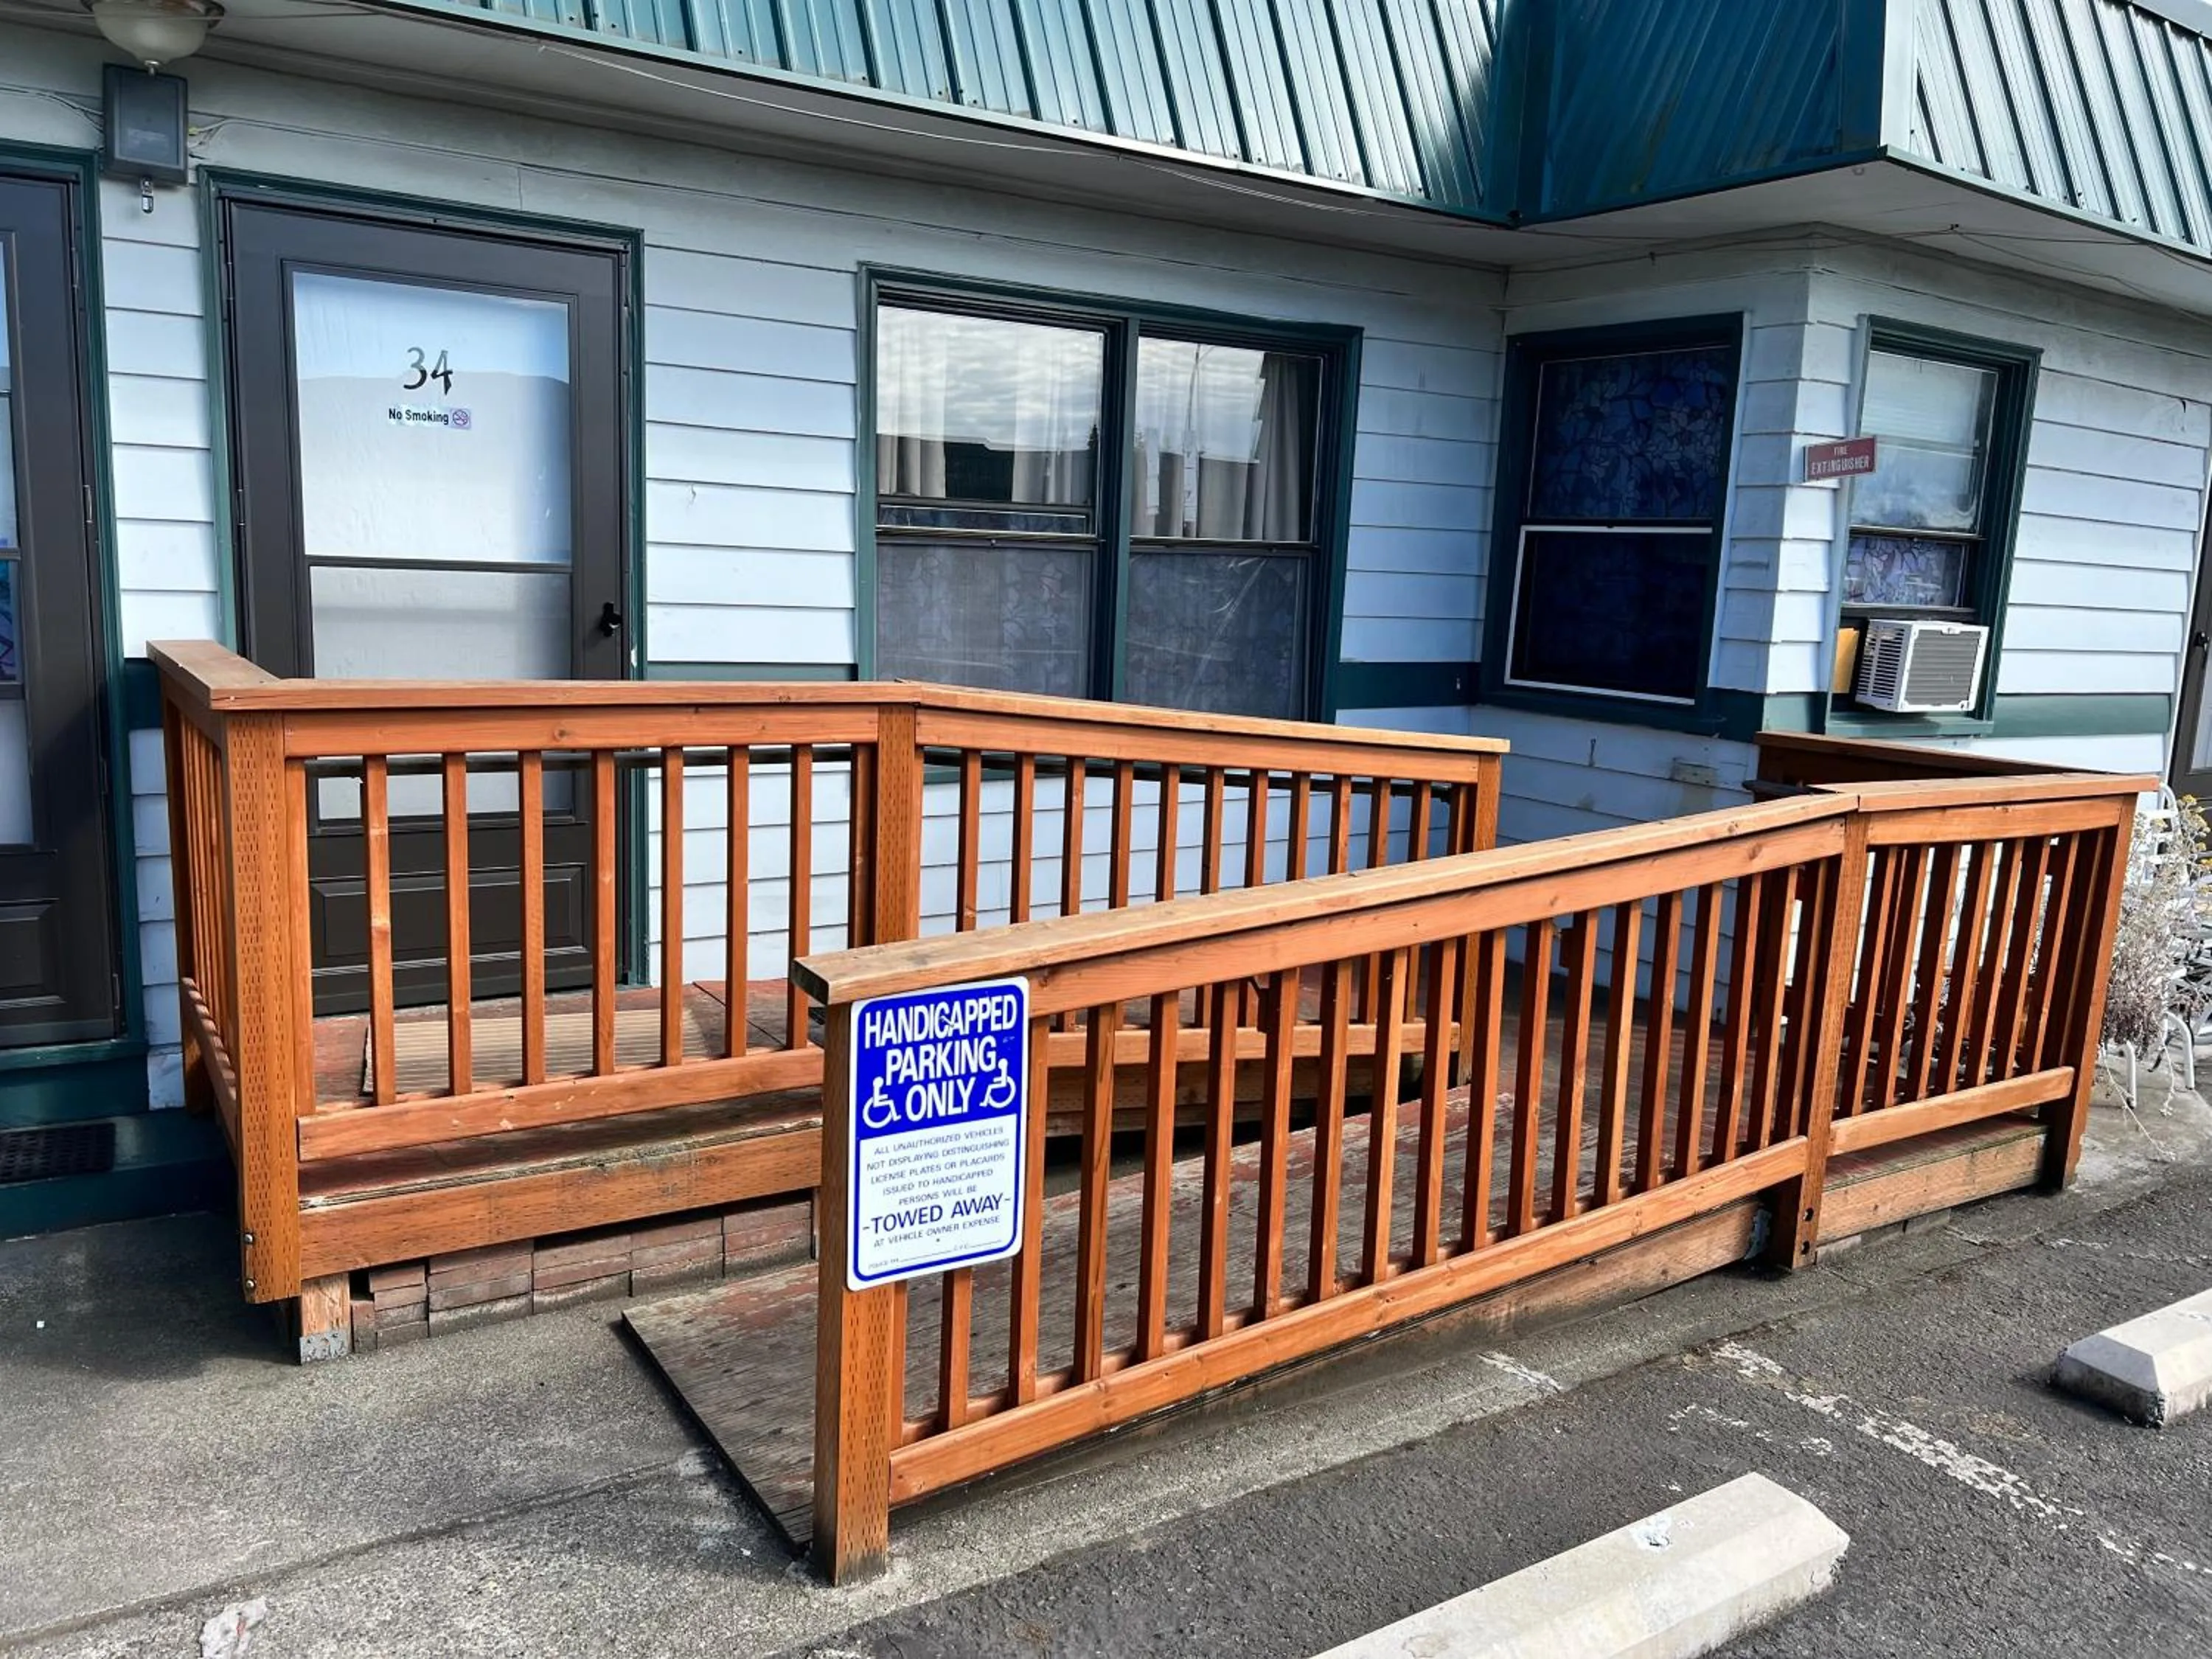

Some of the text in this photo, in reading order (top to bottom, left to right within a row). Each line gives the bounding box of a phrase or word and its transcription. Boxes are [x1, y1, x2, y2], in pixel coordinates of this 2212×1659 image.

[403, 347, 453, 396] 34
[389, 408, 449, 425] No Smoking
[1811, 455, 1869, 476] EXTINGUISHER
[865, 994, 1018, 1049] HANDICAPPED
[886, 1035, 997, 1086] PARKING
[905, 1077, 976, 1122] ONLY
[867, 1138, 1009, 1171] NOT DISPLAYING DISTINGUISHING
[874, 1127, 1004, 1155] ALL UNAUTHORIZED VEHICLES
[871, 1152, 1005, 1185] LICENSE PLATES OR PLACARDS
[883, 1169, 993, 1196] ISSUED TO HANDICAPPED
[899, 1184, 977, 1205] PERSONS WILL BE
[874, 1215, 1000, 1248] AT VEHICLE OWNER EXPENSE
